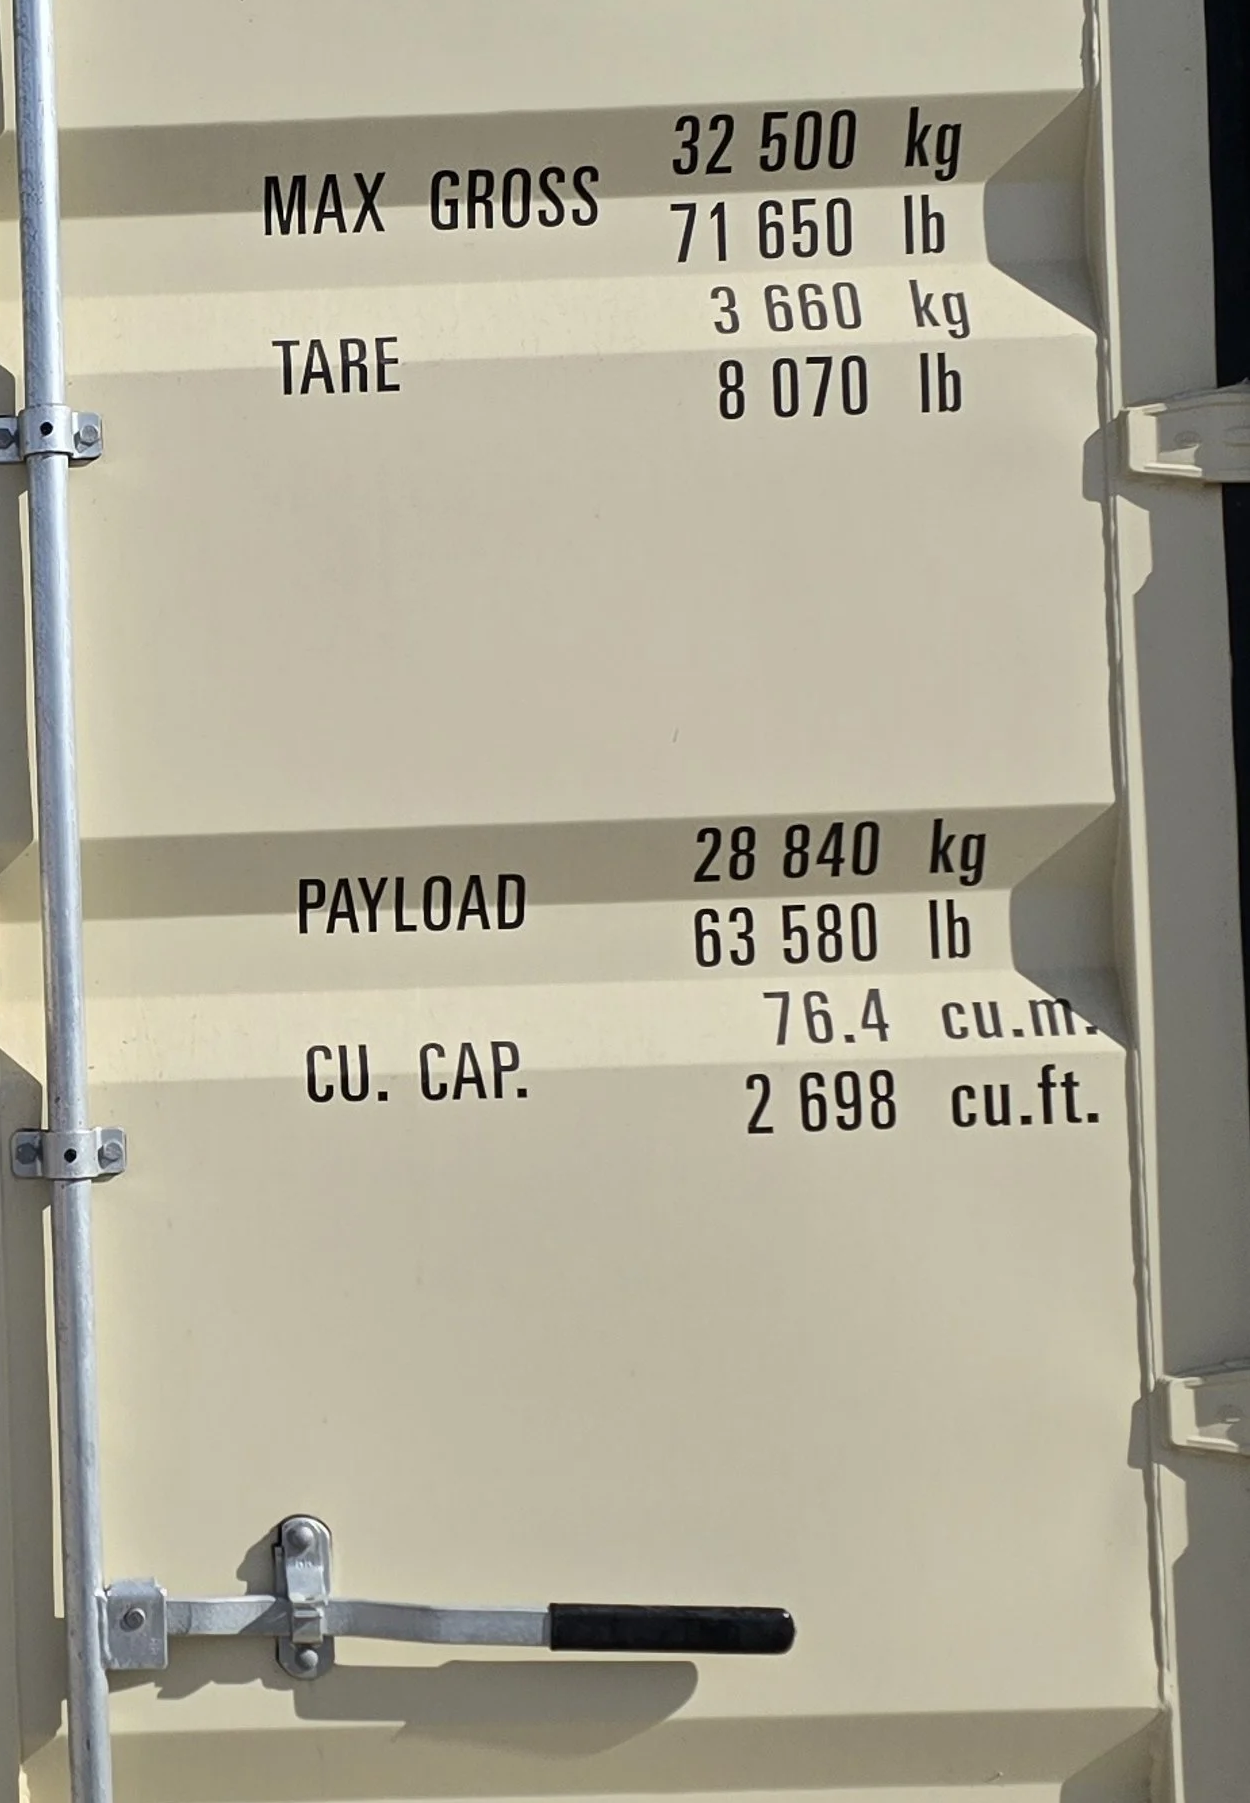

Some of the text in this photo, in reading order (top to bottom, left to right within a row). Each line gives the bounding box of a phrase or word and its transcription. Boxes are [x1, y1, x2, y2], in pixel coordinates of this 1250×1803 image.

[672, 106, 962, 181] 32 500 kg
[264, 166, 599, 236] MAX GROSS
[670, 194, 946, 263] 71 650 lb
[710, 278, 971, 339] 3 660 kg
[273, 337, 401, 396] TARE
[718, 352, 962, 420] 8 070 lb
[694, 818, 987, 886] 28 840 kg
[298, 873, 527, 934] PAYLOAD
[694, 898, 972, 968] 63 580 lb
[762, 988, 1098, 1045] 76.4 cu.m.
[306, 1041, 529, 1103] CU. CAP.
[746, 1064, 1100, 1135] 2 698 cu.ft.
